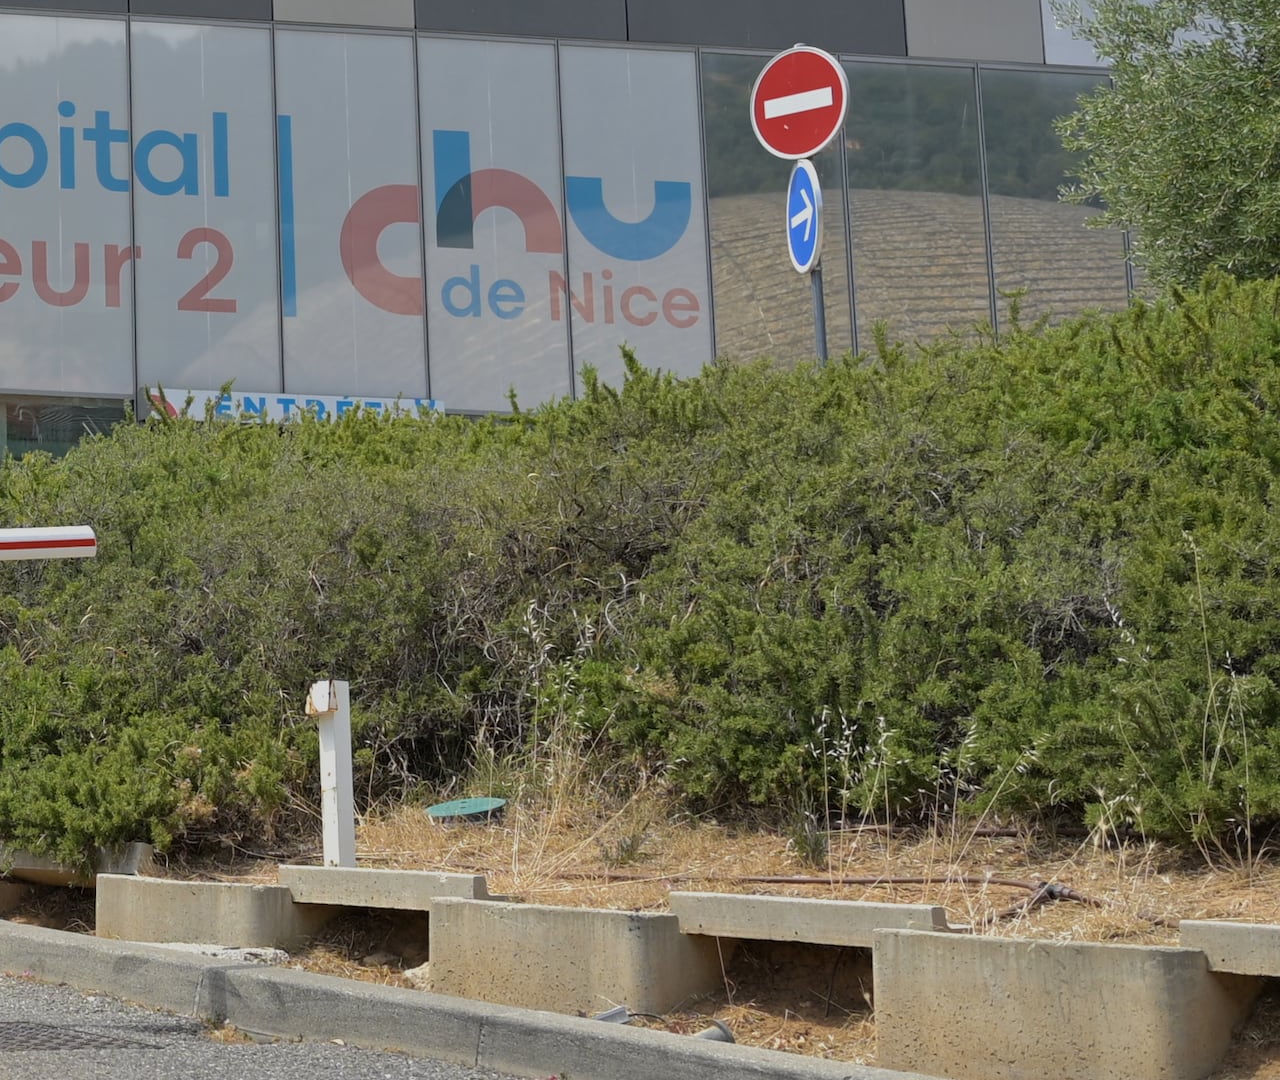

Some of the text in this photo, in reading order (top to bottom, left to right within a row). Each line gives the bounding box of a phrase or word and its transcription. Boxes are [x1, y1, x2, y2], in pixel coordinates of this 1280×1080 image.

[339, 129, 692, 316] chu
[176, 226, 238, 313] 2
[440, 263, 701, 329] de Nice
